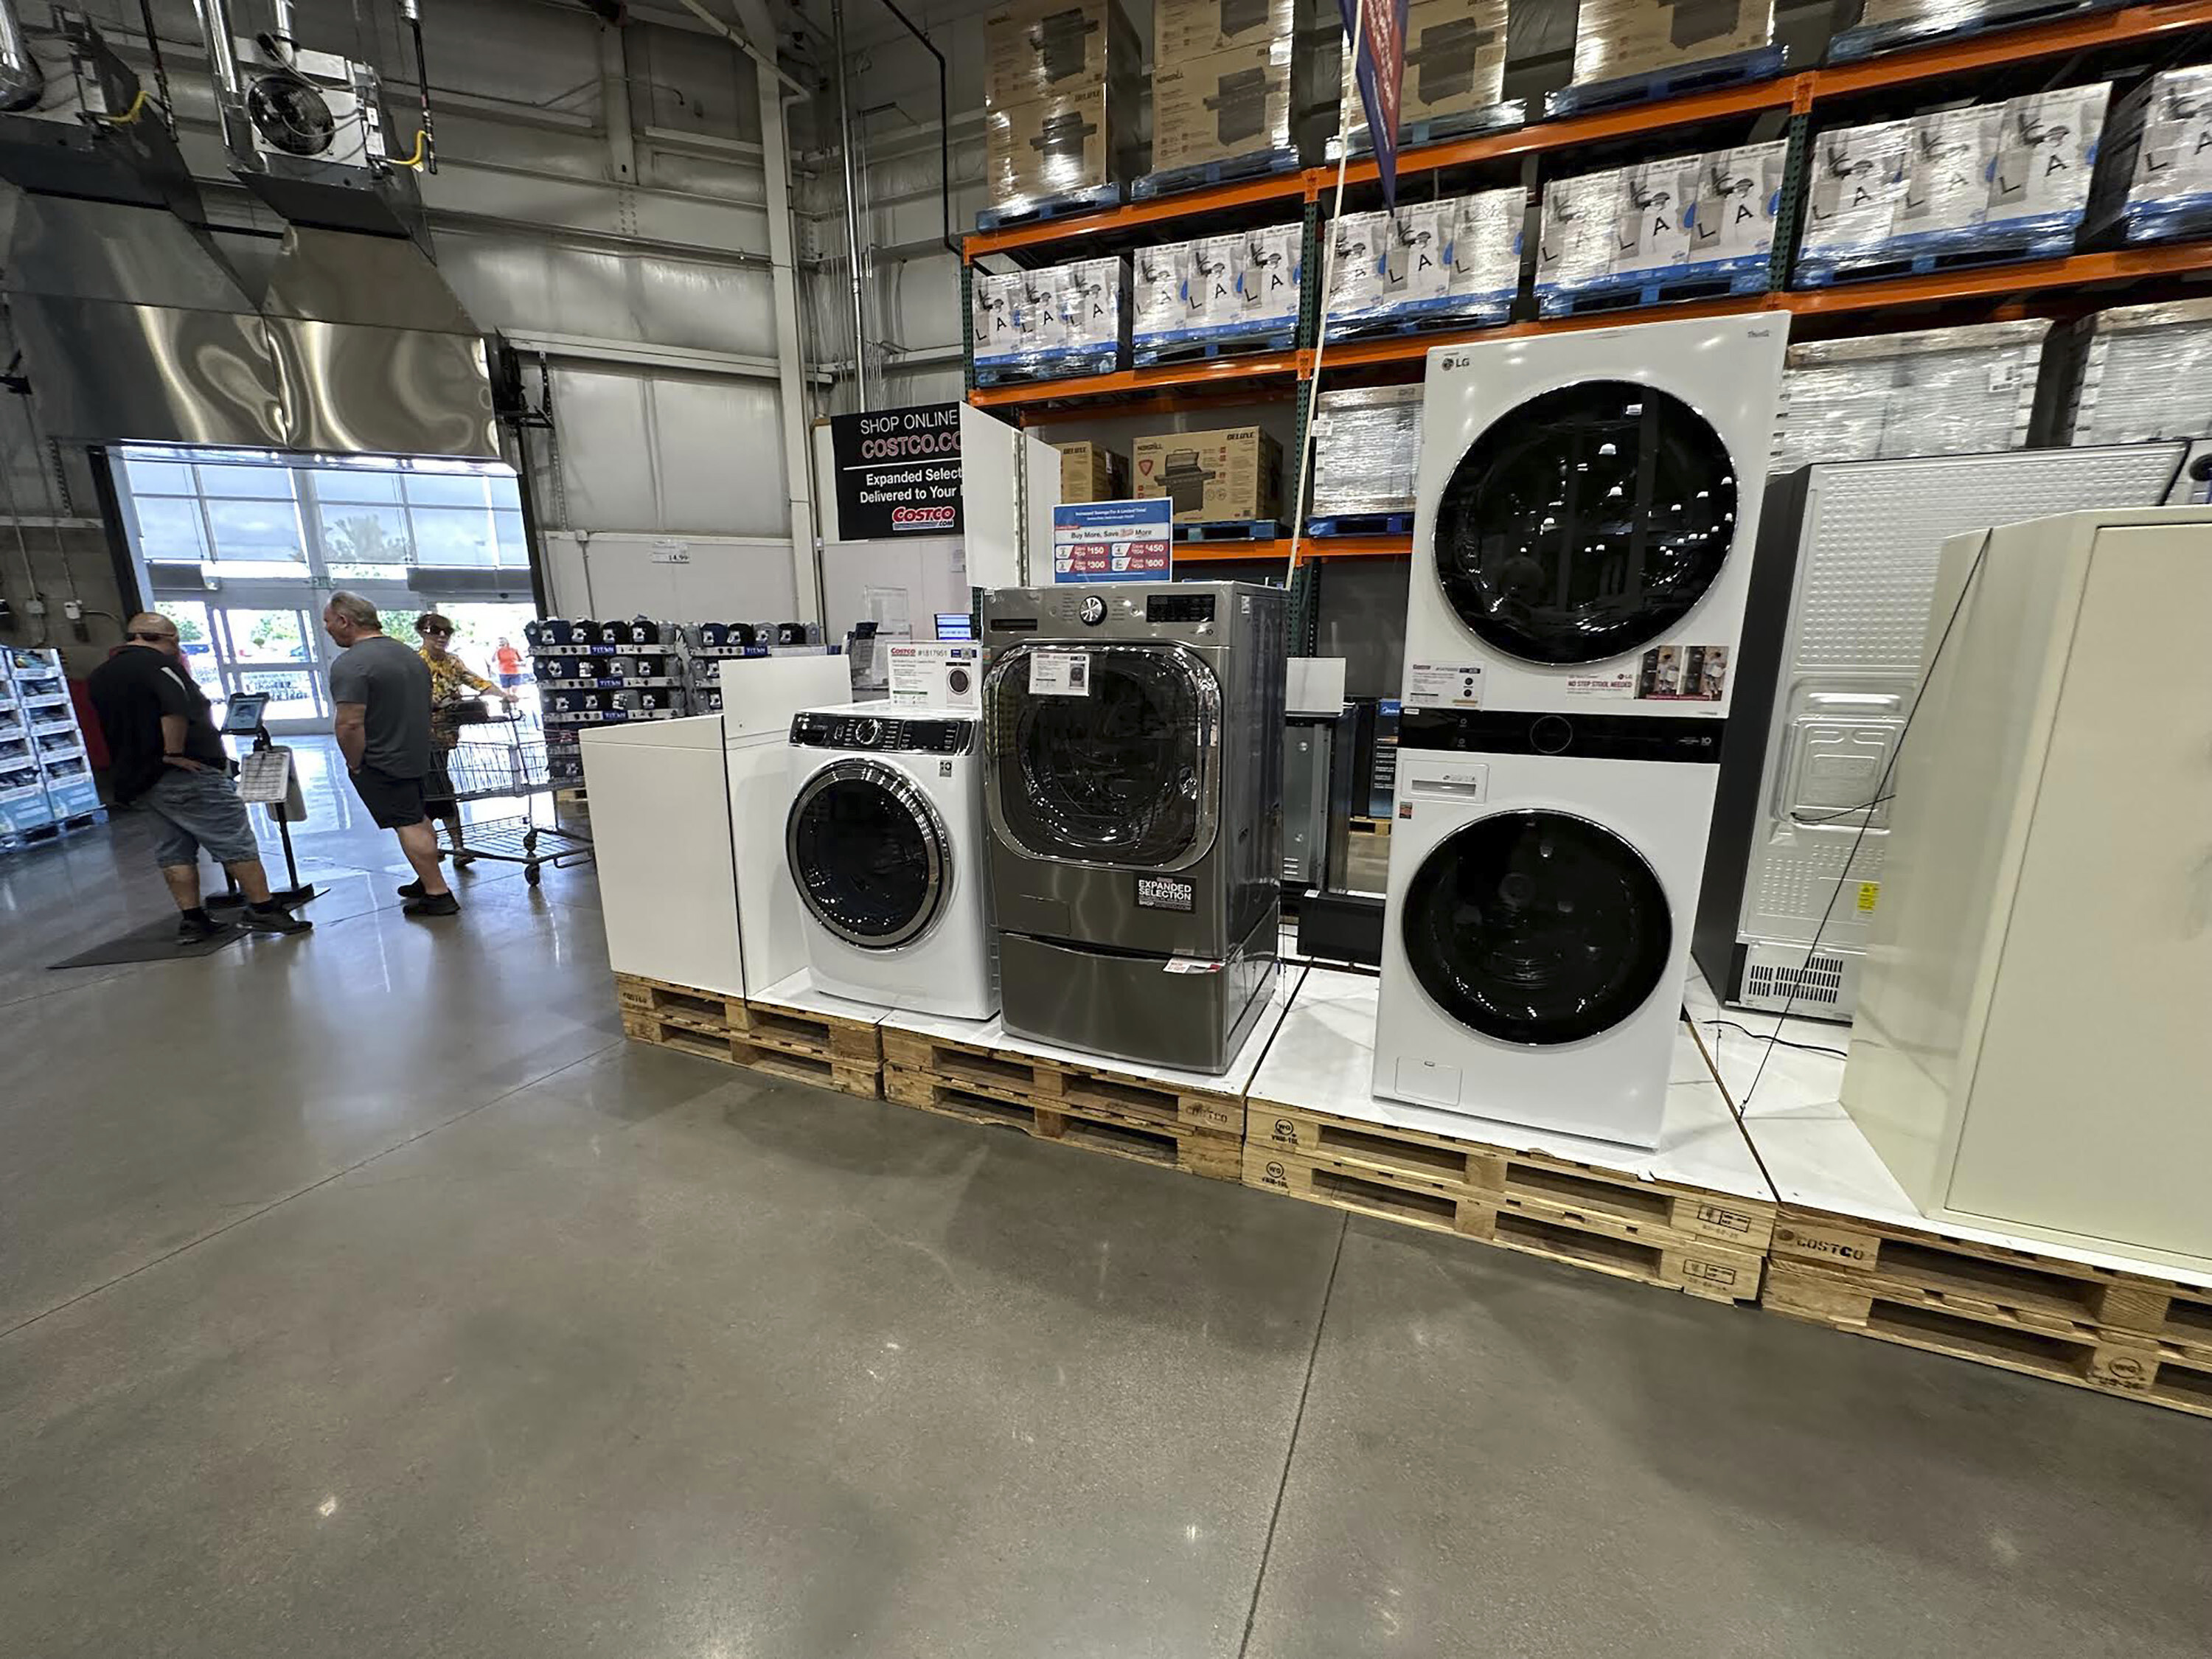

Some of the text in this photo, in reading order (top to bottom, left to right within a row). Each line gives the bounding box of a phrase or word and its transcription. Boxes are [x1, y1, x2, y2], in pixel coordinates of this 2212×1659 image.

[1999, 154, 2067, 195] L A
[1853, 187, 1872, 206] A
[1653, 217, 1671, 236] A
[1698, 204, 1753, 240] L A
[1541, 247, 1558, 262] L
[1388, 254, 1433, 284] L A
[1455, 259, 1470, 274] L
[1189, 283, 1227, 310] L A
[1245, 274, 1284, 302] L A
[1043, 310, 1054, 325] A
[1093, 303, 1104, 318] A
[975, 317, 1007, 341] L A
[1455, 358, 1470, 368] LG
[860, 409, 959, 435] SHOP ONLINE
[861, 431, 961, 459] COSTCO.CO
[866, 467, 963, 487] Expanded Select
[860, 488, 912, 504] Delivered
[914, 487, 927, 500] to
[929, 485, 957, 498] Your
[892, 506, 956, 523] COSTCO
[1071, 532, 1082, 540] Buy
[1088, 546, 1105, 554] $150
[1146, 544, 1164, 552] $450
[1088, 560, 1105, 568] $300
[1146, 559, 1164, 567] $600
[891, 647, 916, 655] COSTCO
[1138, 880, 1192, 893] EXPANDED
[1138, 886, 1192, 900] SELECTION
[1796, 1238, 1864, 1261] COSTCO
